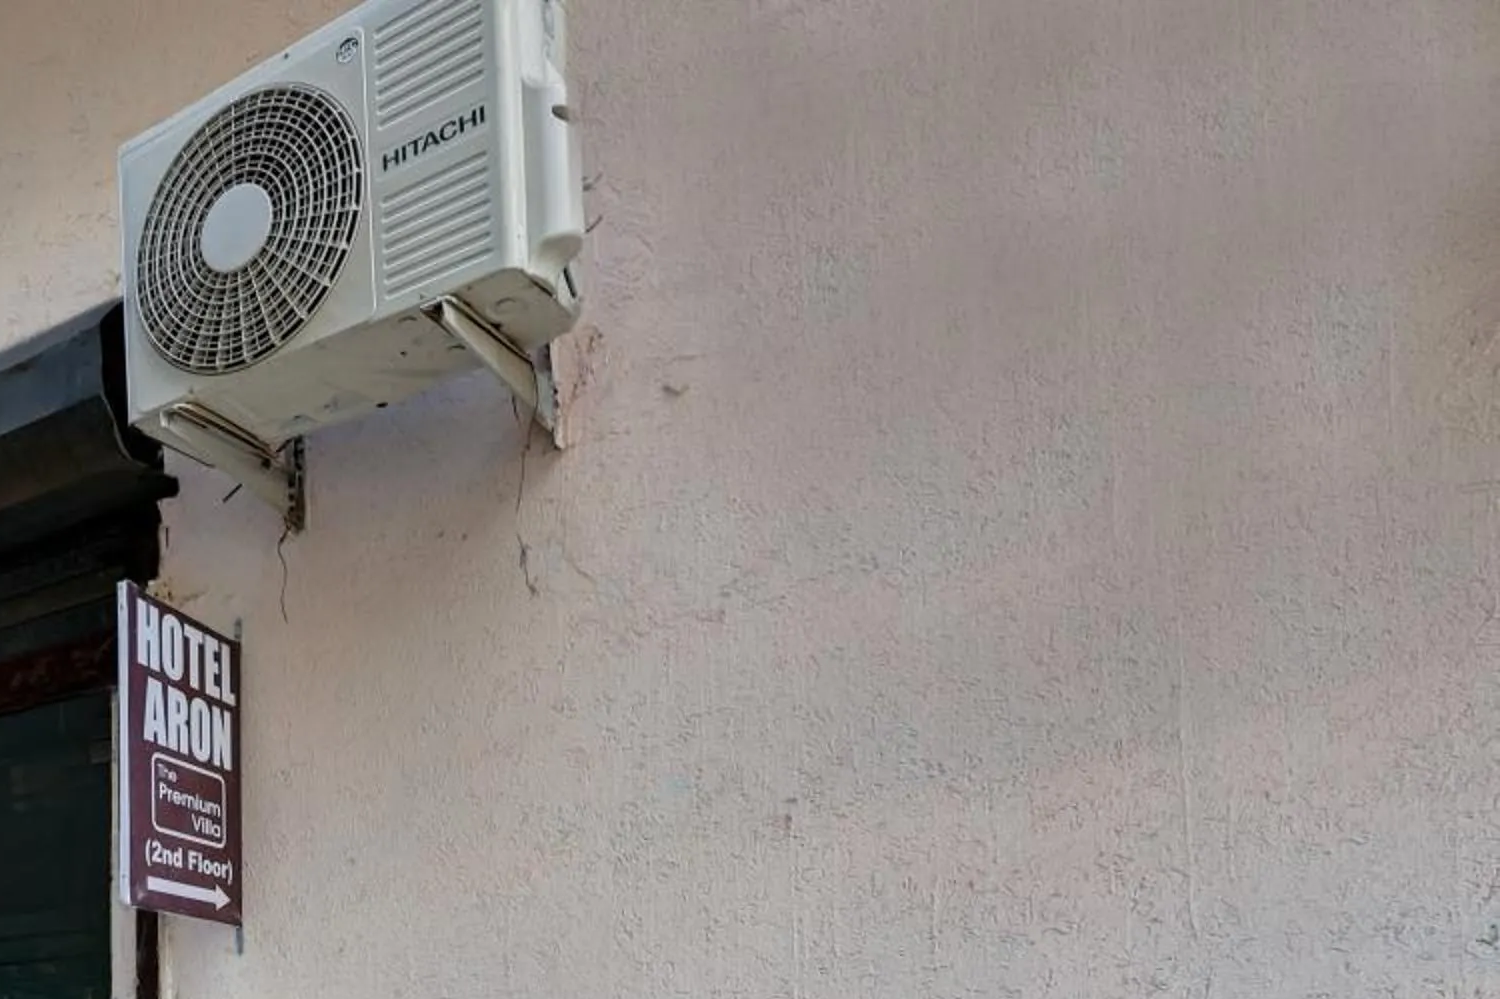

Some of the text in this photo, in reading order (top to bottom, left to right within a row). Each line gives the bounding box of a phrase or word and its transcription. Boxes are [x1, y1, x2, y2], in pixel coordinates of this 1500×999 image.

[383, 105, 486, 171] HITACHI
[137, 598, 236, 707] HOTEL
[144, 677, 233, 771] ARON
[159, 781, 221, 817] Premium
[191, 813, 221, 838] Villa
[145, 838, 233, 886] (2nd Floor)
